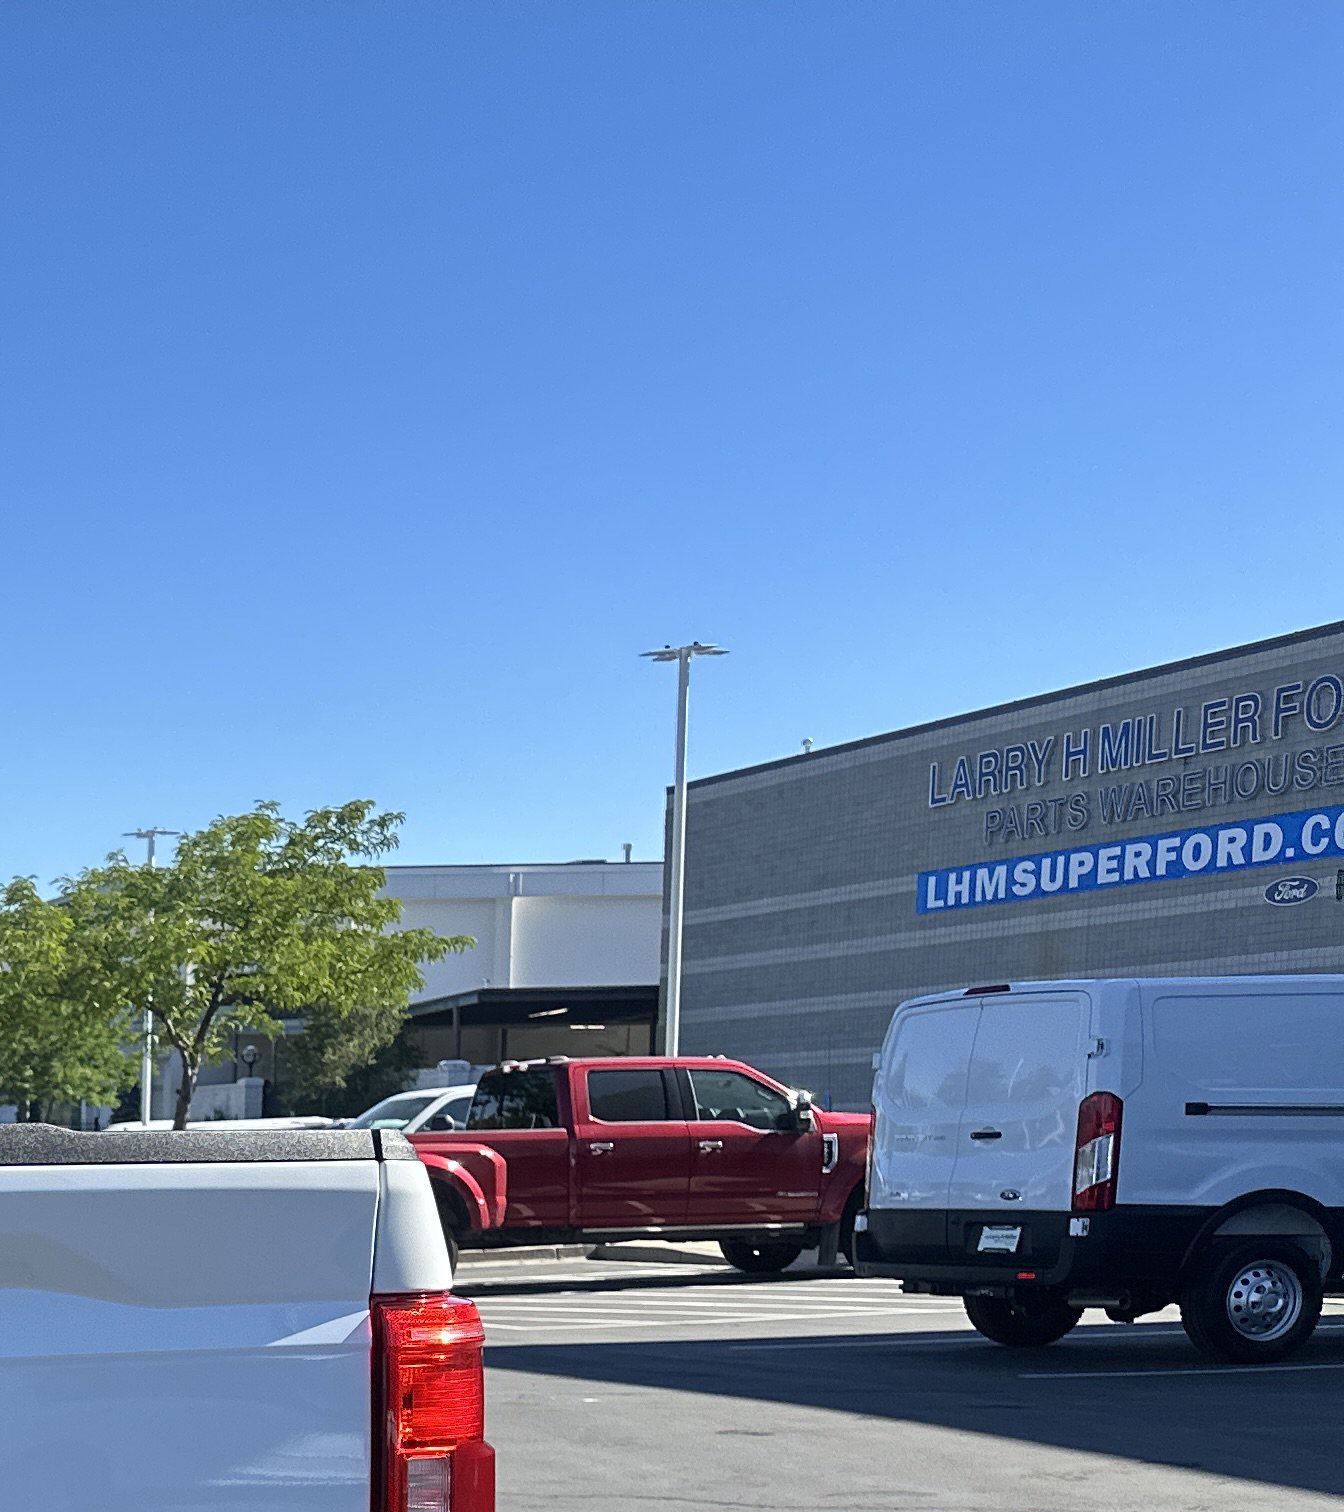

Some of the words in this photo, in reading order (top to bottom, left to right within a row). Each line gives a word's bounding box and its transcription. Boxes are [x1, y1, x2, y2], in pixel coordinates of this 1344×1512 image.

[928, 732, 1055, 808] LARRY
[1062, 728, 1091, 781] H
[1098, 692, 1262, 774] MILLER
[984, 792, 1089, 846] PARTS
[1099, 744, 1344, 825] WAREHOUSE
[1274, 881, 1309, 901] Ford
